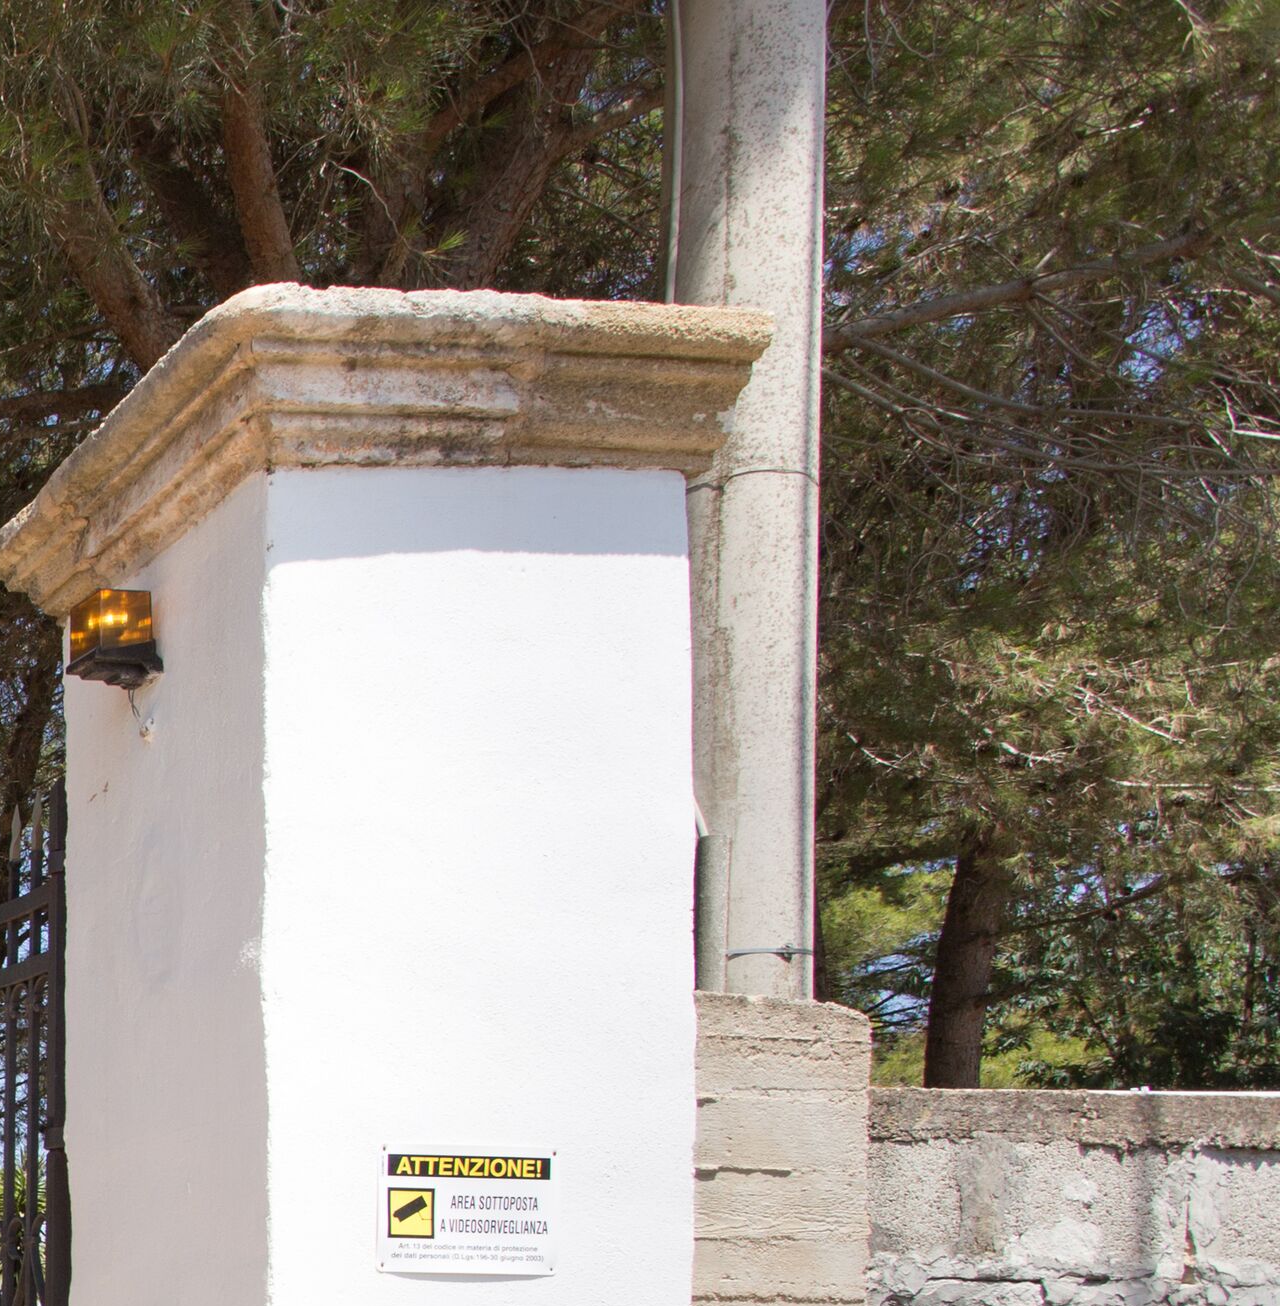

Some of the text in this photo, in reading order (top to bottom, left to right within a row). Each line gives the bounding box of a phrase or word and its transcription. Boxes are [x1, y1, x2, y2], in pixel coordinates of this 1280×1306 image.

[396, 1156, 542, 1178] ATTENZIONE!
[450, 1195, 539, 1211] AREA SOTTOPOSTA
[440, 1218, 548, 1235] A VIDEOSORVEGLIANZA
